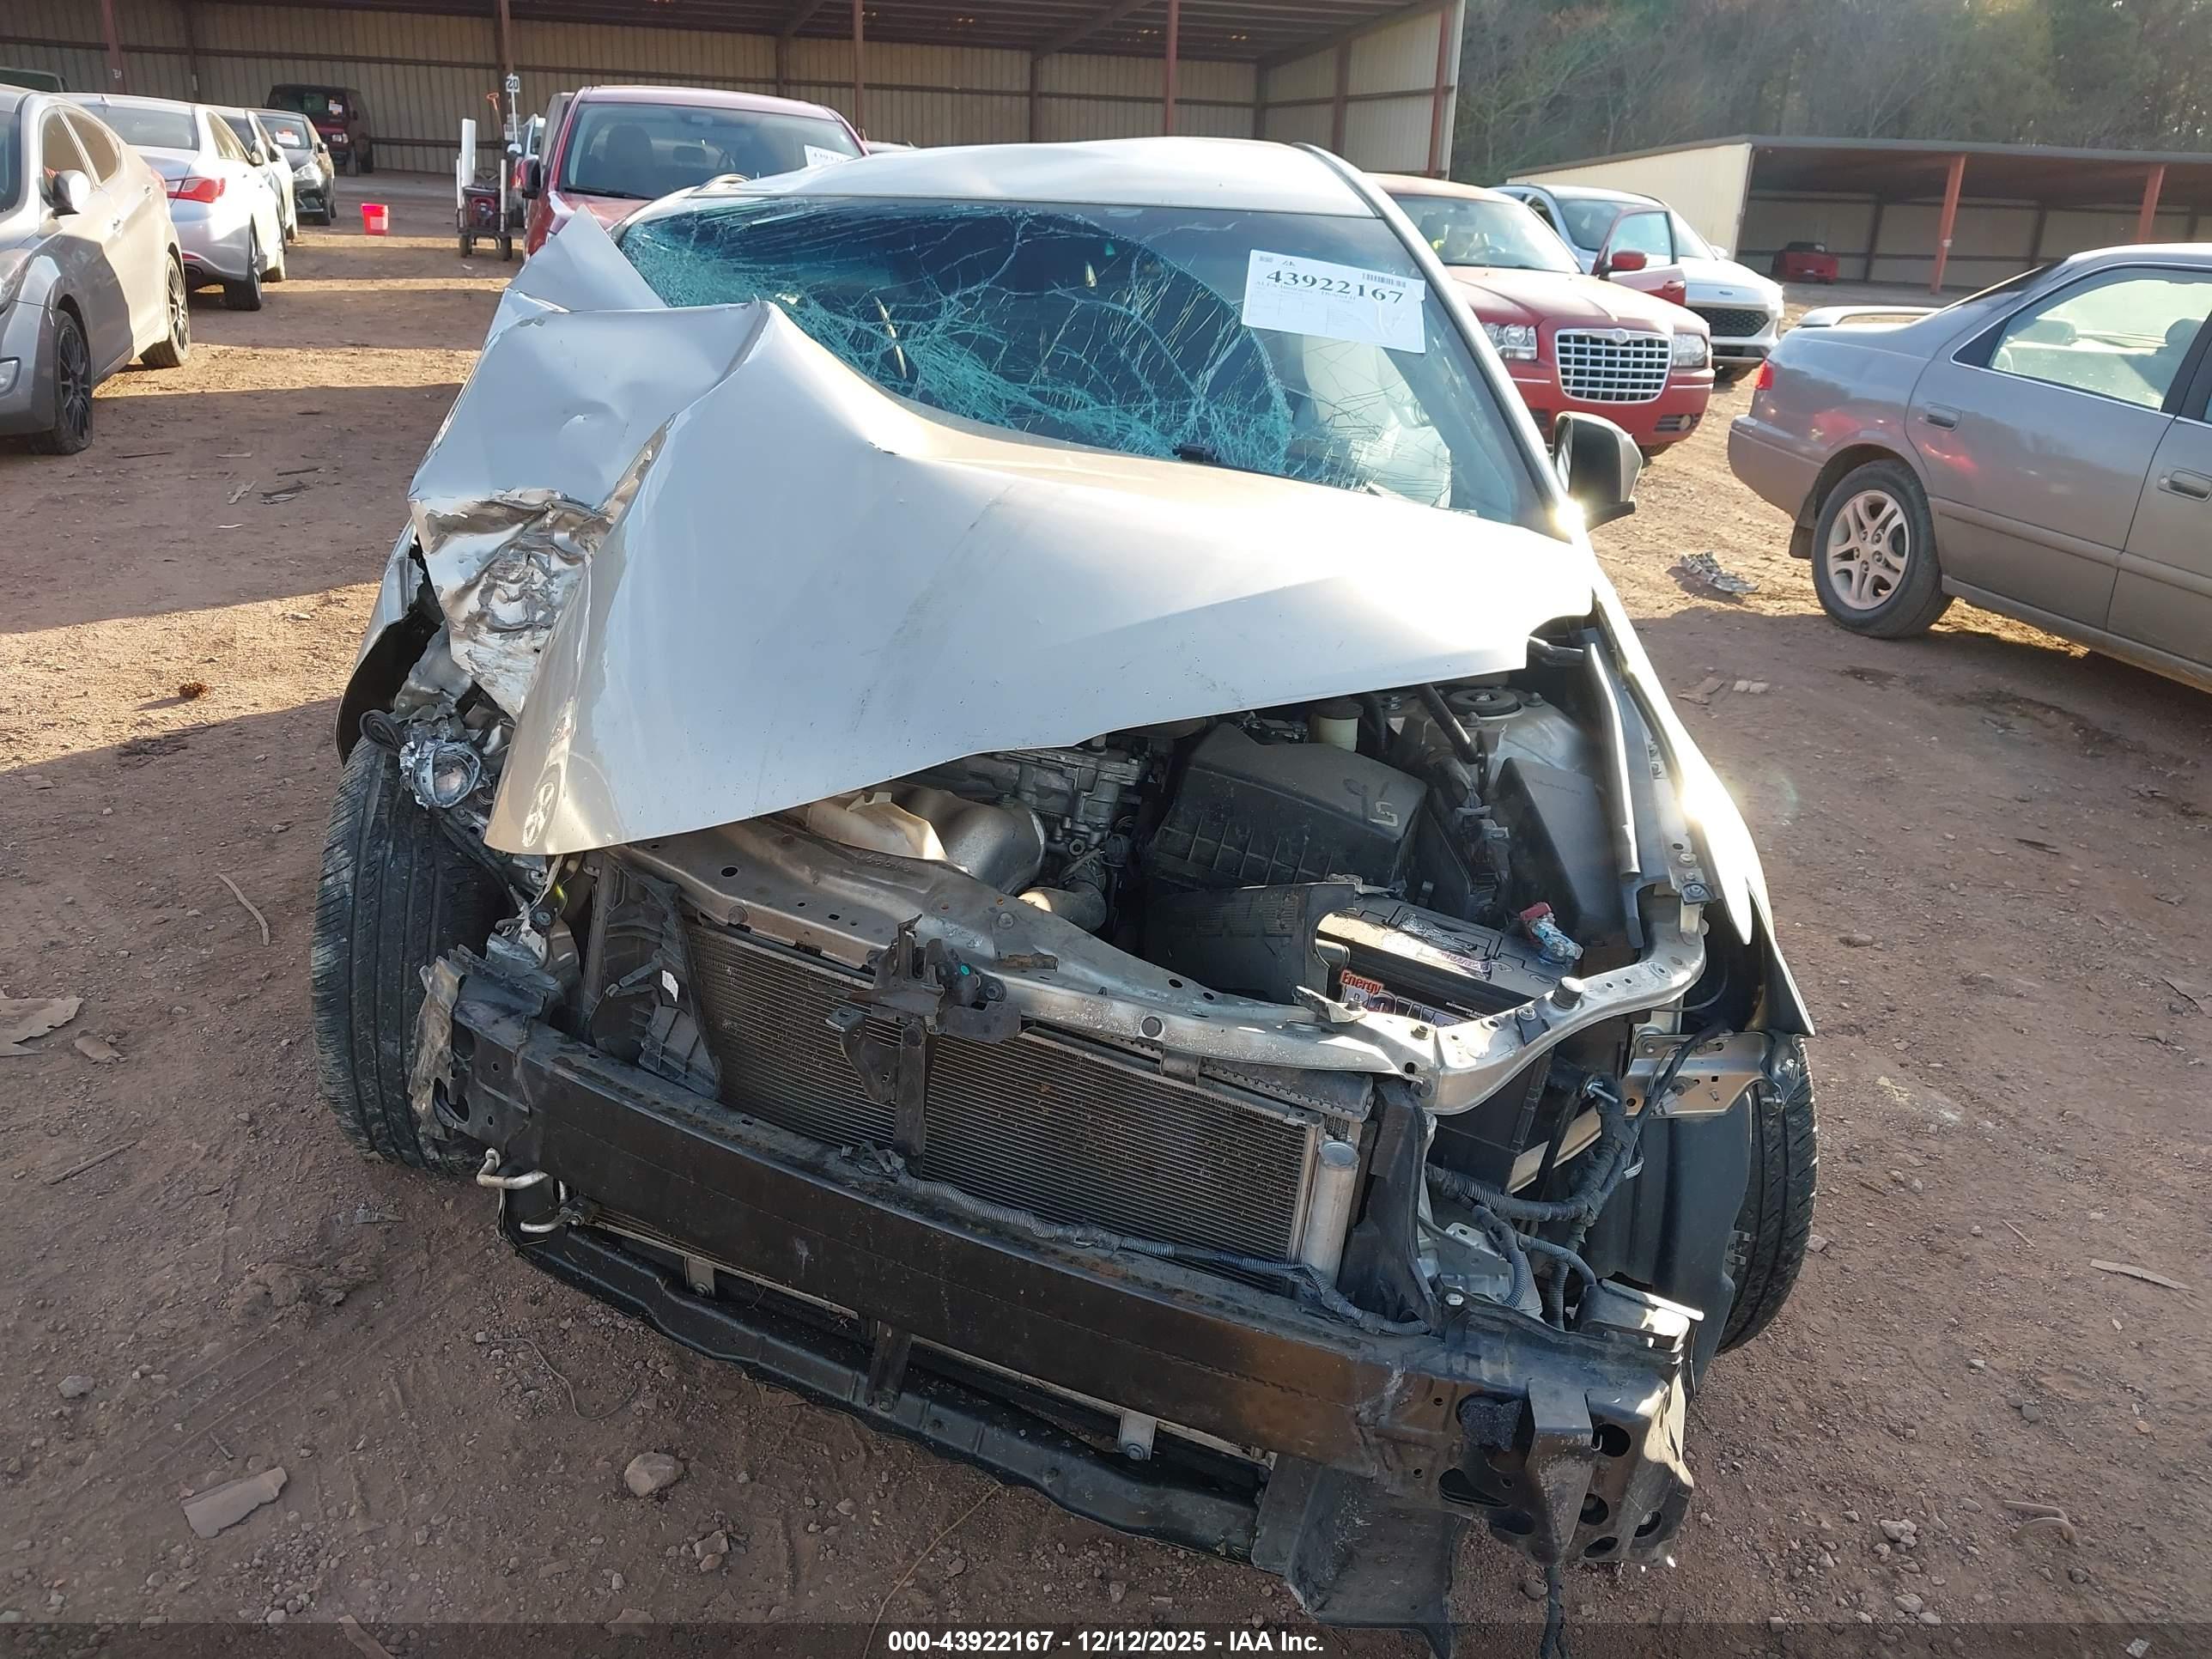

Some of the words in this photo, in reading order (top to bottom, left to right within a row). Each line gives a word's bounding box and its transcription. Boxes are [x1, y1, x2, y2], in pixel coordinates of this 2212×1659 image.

[507, 78, 519, 89] 20
[1267, 270, 1403, 303] 43922167
[1341, 970, 1382, 995] Energy
